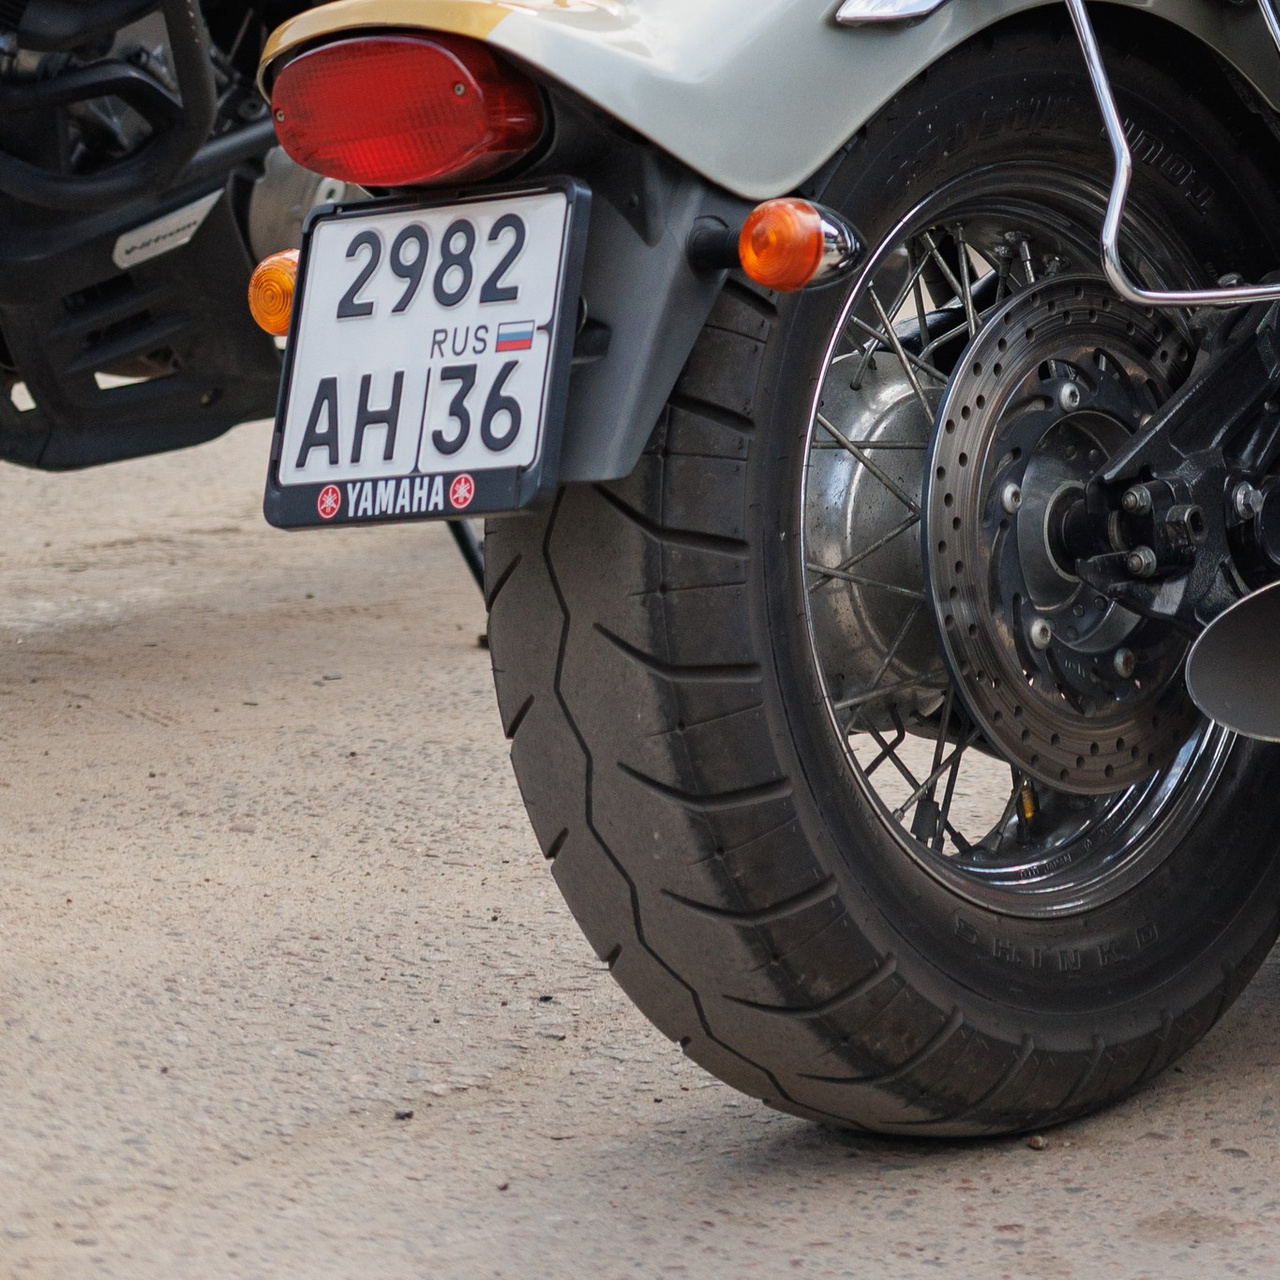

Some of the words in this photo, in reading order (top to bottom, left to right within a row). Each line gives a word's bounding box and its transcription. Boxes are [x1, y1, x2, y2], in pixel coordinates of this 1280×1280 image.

[337, 213, 526, 319] 2982
[430, 324, 489, 359] RUS
[295, 370, 405, 468] AH
[431, 360, 522, 456] 36
[347, 475, 444, 517] YAMAHA
